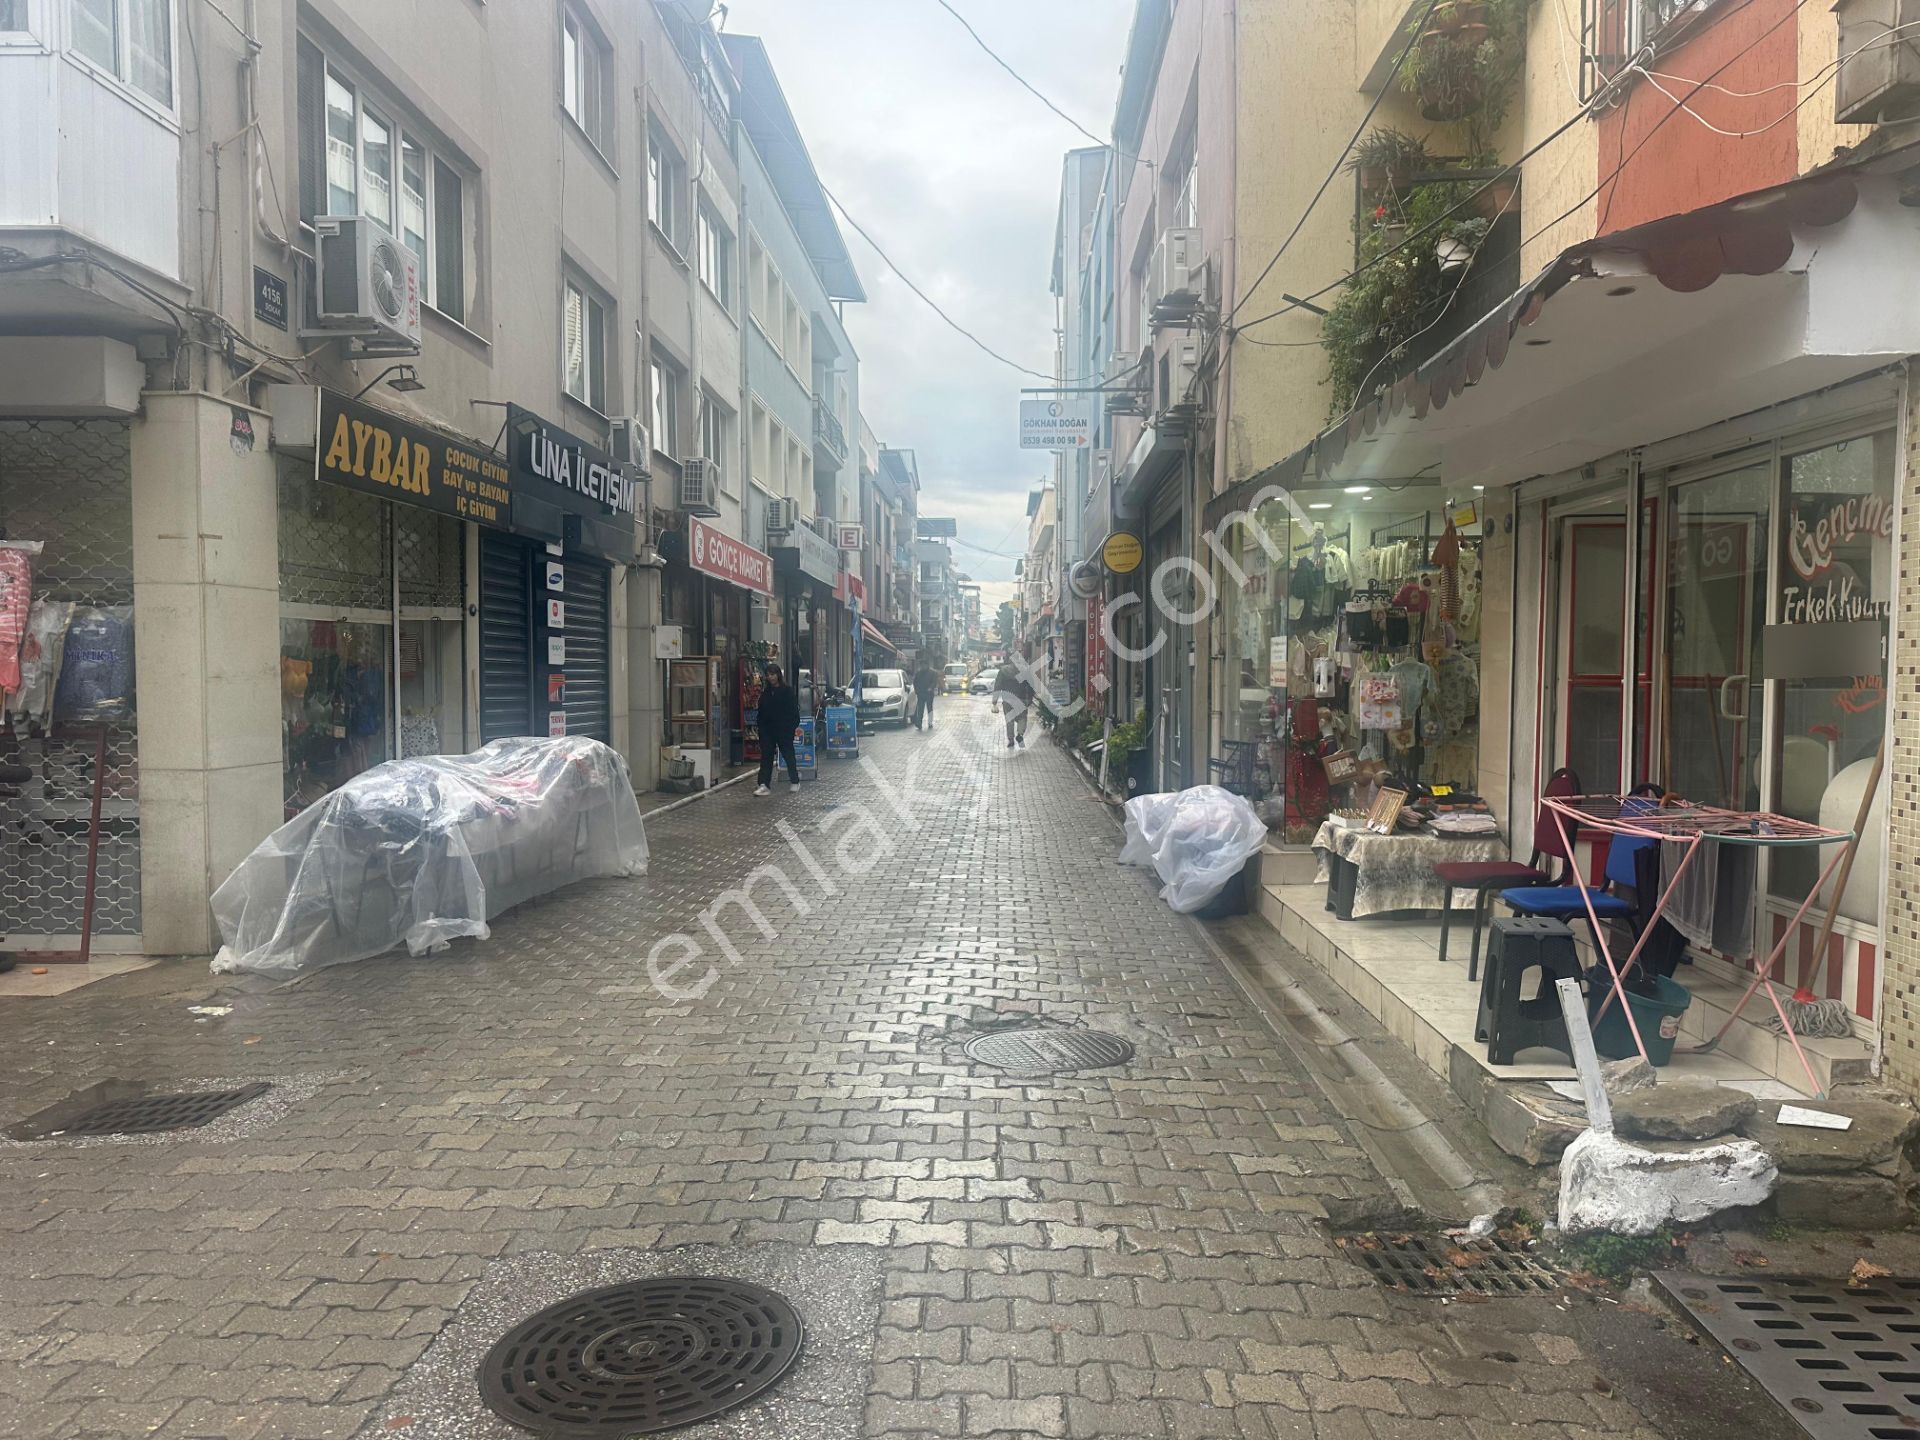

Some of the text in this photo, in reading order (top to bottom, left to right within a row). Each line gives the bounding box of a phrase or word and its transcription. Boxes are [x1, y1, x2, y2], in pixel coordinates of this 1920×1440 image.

[264, 302, 281, 317] SOKAK
[1023, 416, 1088, 428] GÖKHAN DOĞAN
[1041, 436, 1055, 445] 498
[1056, 436, 1066, 445] 00
[1067, 436, 1077, 445] 98
[324, 412, 432, 497] AYBAR
[445, 447, 509, 485] ÇOCUK GİYİM
[531, 428, 634, 516] LİNA İLETİŞİM
[442, 468, 510, 505] BAY ve BAYAN
[456, 491, 497, 521] İÇ GİYİM
[843, 531, 856, 545] E
[709, 533, 738, 578] GÖKÇE
[739, 551, 764, 584] MARKET
[1782, 579, 1837, 625] Erkek
